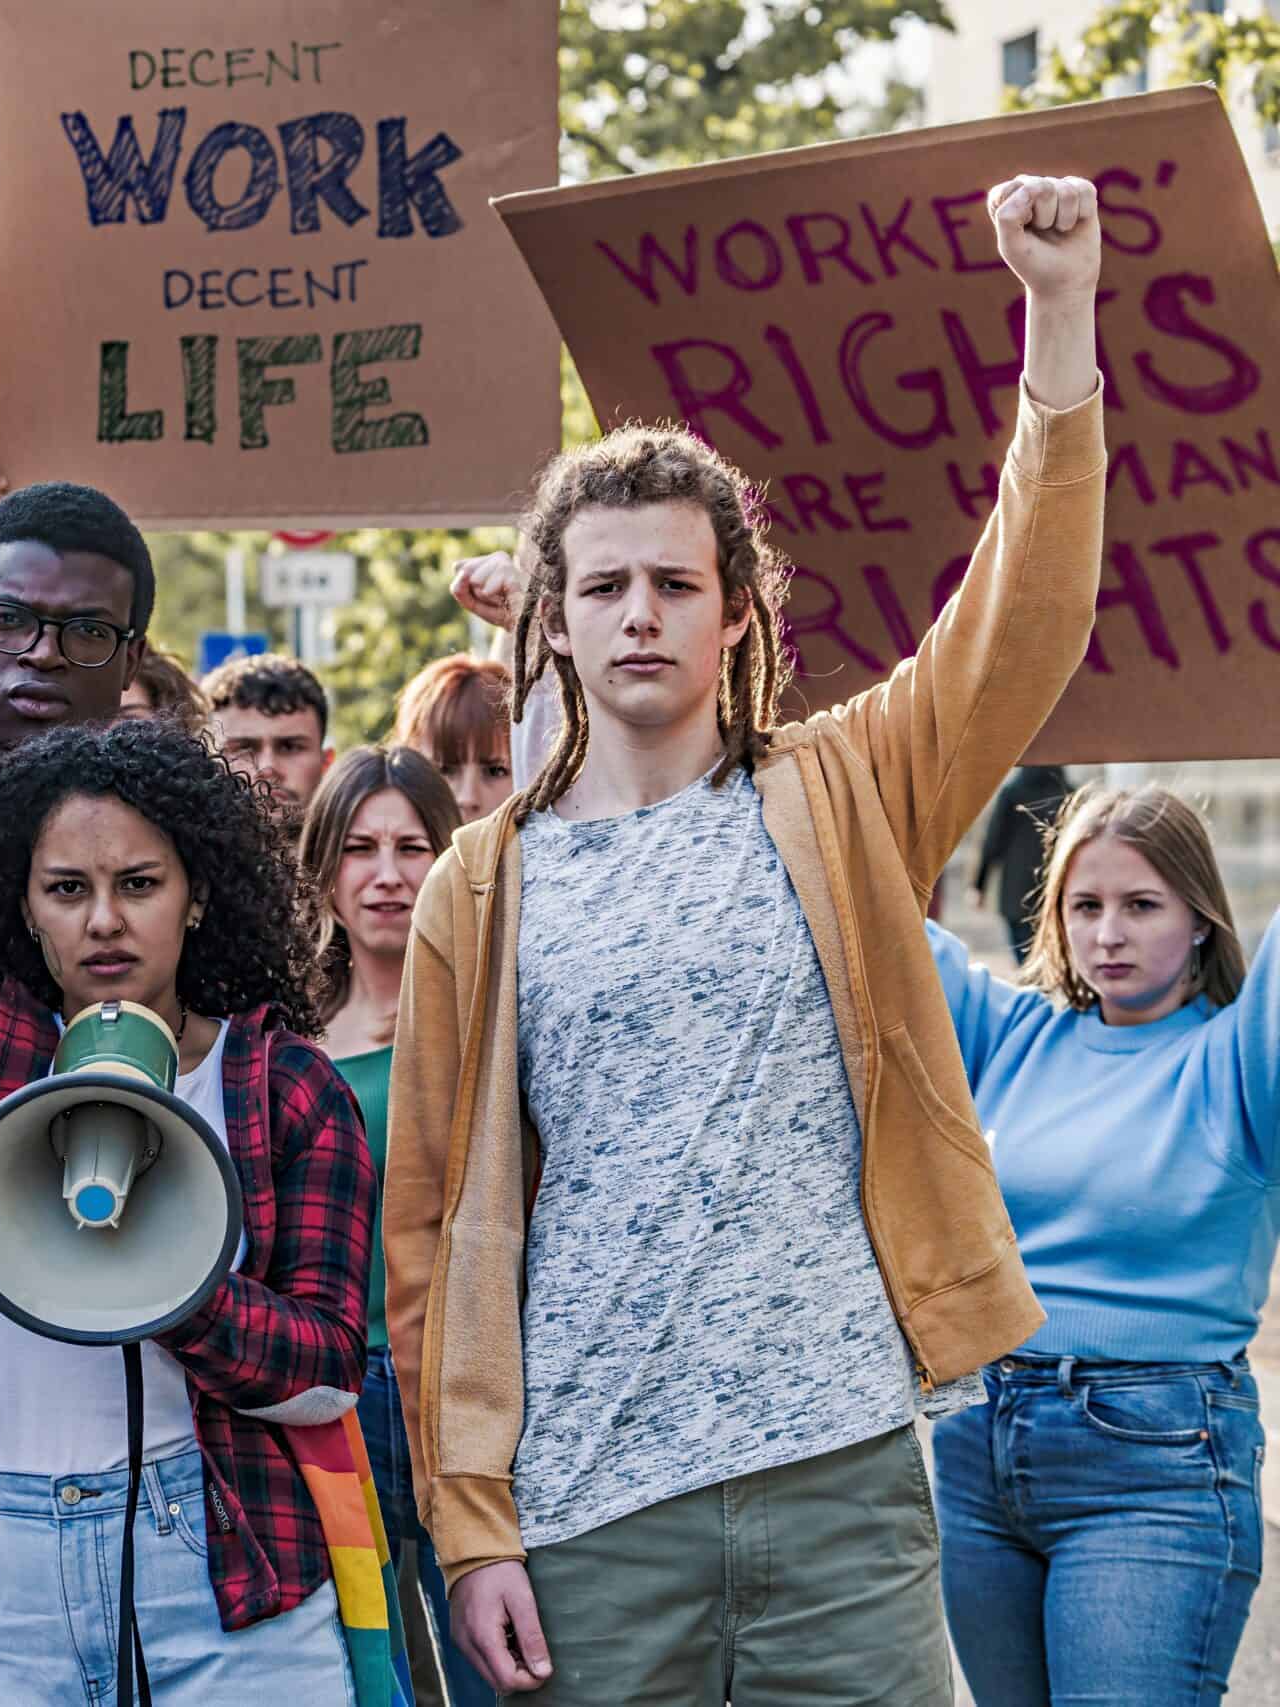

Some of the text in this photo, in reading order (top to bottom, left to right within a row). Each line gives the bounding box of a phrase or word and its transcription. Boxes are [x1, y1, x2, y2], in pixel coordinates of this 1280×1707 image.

[128, 41, 344, 90] DECENT
[60, 106, 465, 240] WORK
[596, 160, 1178, 306] WORKES'
[163, 259, 370, 310] DECENT
[96, 323, 430, 454] LIFE
[946, 427, 1280, 520] HAN
[780, 528, 1280, 677] RIHT
